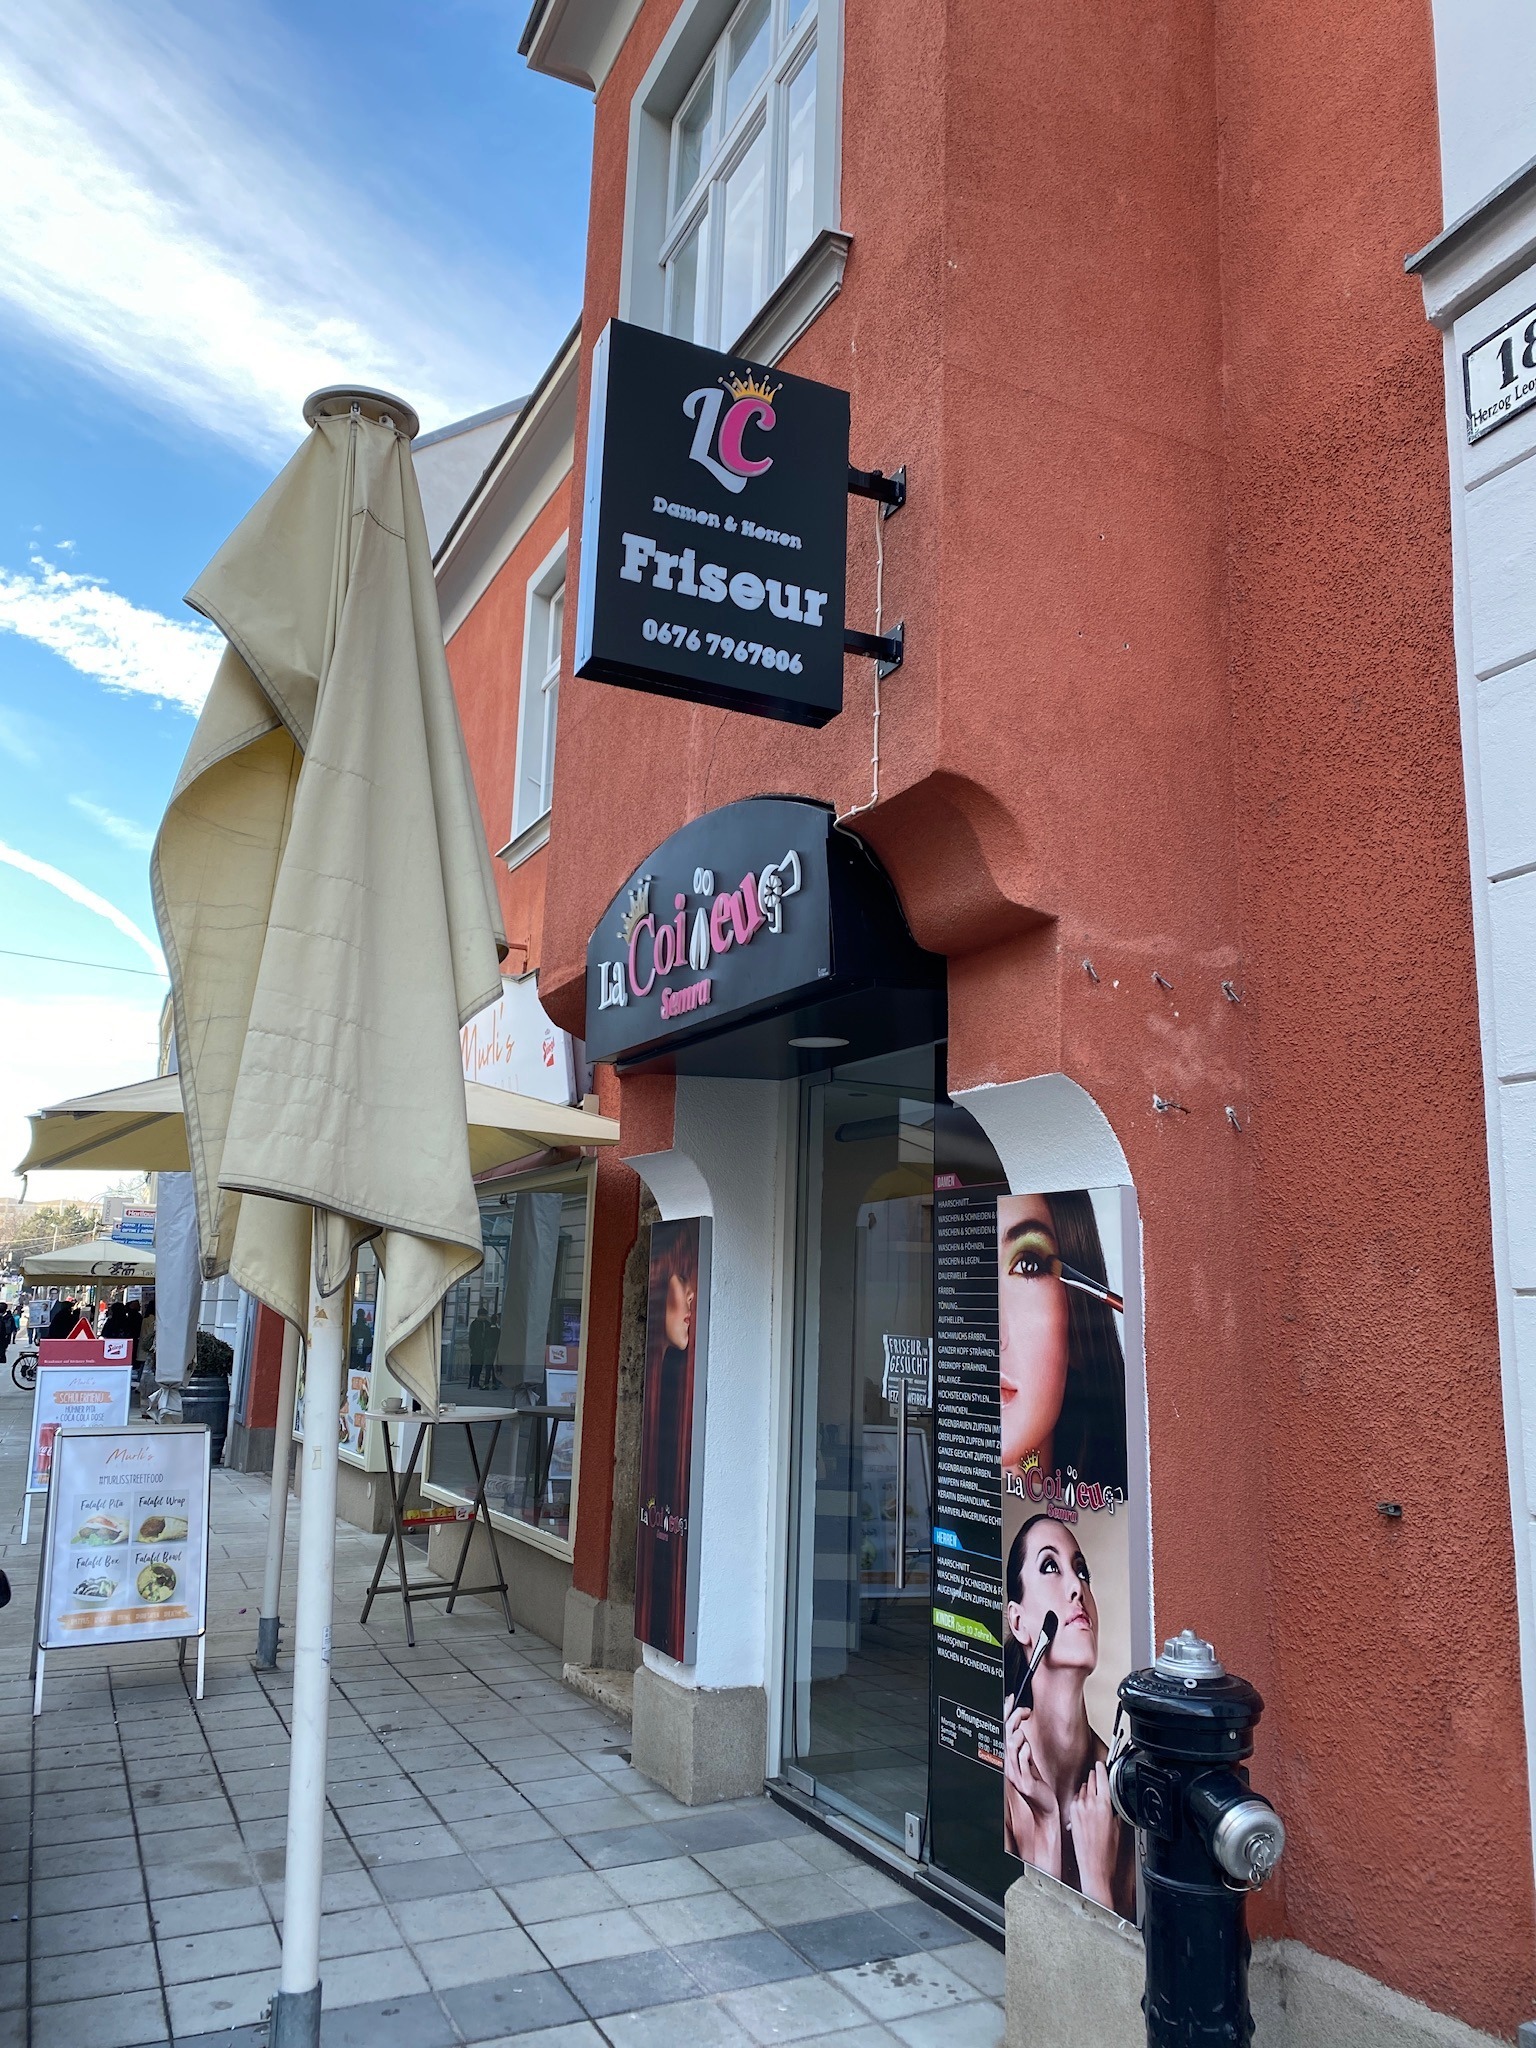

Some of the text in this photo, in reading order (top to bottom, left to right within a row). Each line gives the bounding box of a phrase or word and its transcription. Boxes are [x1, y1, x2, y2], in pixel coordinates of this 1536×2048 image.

[1471, 378, 1536, 427] Herzog Leo
[652, 496, 803, 551] Damen & Herren
[620, 532, 828, 627] Friseur
[642, 618, 804, 675] 0676 7967806
[598, 961, 628, 1010] La
[661, 978, 712, 1020] Semra
[937, 1176, 955, 1188] DAMEN
[938, 1198, 969, 1208] HAARSCHNITT
[938, 1214, 960, 1222] WASCHEN
[965, 1212, 991, 1221] SCHNEIDEN
[938, 1228, 960, 1236] WASCHEN
[965, 1226, 991, 1235] SCHNEIDEN
[965, 1242, 984, 1250] FÖHNEN
[938, 1257, 960, 1265] WASCHEN
[965, 1256, 980, 1264] LEGEN
[938, 1272, 967, 1280] DAUERWELLE
[938, 1286, 955, 1294] FÄRBEN
[938, 1301, 957, 1310] TÖNUNG
[938, 1331, 986, 1341] NACHWUCHS FÄRBEN
[938, 1346, 995, 1357] GANZER KOPF STRÄHNEN
[890, 1356, 927, 1375] GESUCHT
[962, 1362, 987, 1372] STRÄHNEN
[938, 1375, 961, 1384] BALAYAGE
[938, 1390, 989, 1403] HOCHSTECKEN STYLEN
[60, 1414, 75, 1422] COCA
[91, 1413, 104, 1421] DOSE
[938, 1418, 972, 1430] AUGENBRAUEN
[973, 1422, 991, 1432] ZUPFEN
[938, 1432, 965, 1444] OBERLIPPEN
[966, 1436, 984, 1447] ZUPFEN
[106, 1447, 153, 1464] Murli's
[938, 1446, 954, 1456] GANZE
[954, 1449, 973, 1460] GESICHT
[974, 1452, 993, 1464] ZUPFEN
[938, 1462, 991, 1478] AUGENBRAUEN FÄRBEN
[99, 1473, 163, 1485] #MURLISSTREETFOOD
[938, 1476, 978, 1490] WIMPERN FÄRBEN
[1006, 1472, 1025, 1499] La
[80, 1498, 123, 1510] Falafel Pita
[139, 1496, 186, 1508] Falafel Wrap
[938, 1490, 990, 1508] KERATIN BEHANDLUNG
[640, 1508, 648, 1526] La
[938, 1505, 988, 1523] HAARVERLÄNGERUNG
[1047, 1503, 1078, 1523] Semra
[936, 1531, 957, 1547] HERREN
[76, 1556, 119, 1569] Falafel Box
[135, 1551, 182, 1566] Falafel Bowl
[937, 1556, 970, 1572] HAARSCHNITT
[937, 1570, 960, 1583] WASCHEN
[965, 1577, 993, 1593] SCHNEIDEN
[994, 1585, 998, 1595] &
[973, 1595, 992, 1608] ZUPFEN
[936, 1610, 992, 1643] KINDER (bis 10 Jahre)
[937, 1632, 969, 1650] HAARSCHNITT
[937, 1647, 960, 1662] WASCHEN
[964, 1656, 991, 1673] SCHNEIDEN
[991, 1664, 995, 1675] &
[941, 1716, 956, 1730] Montag
[956, 1706, 1000, 1735] Öffnungszeiten
